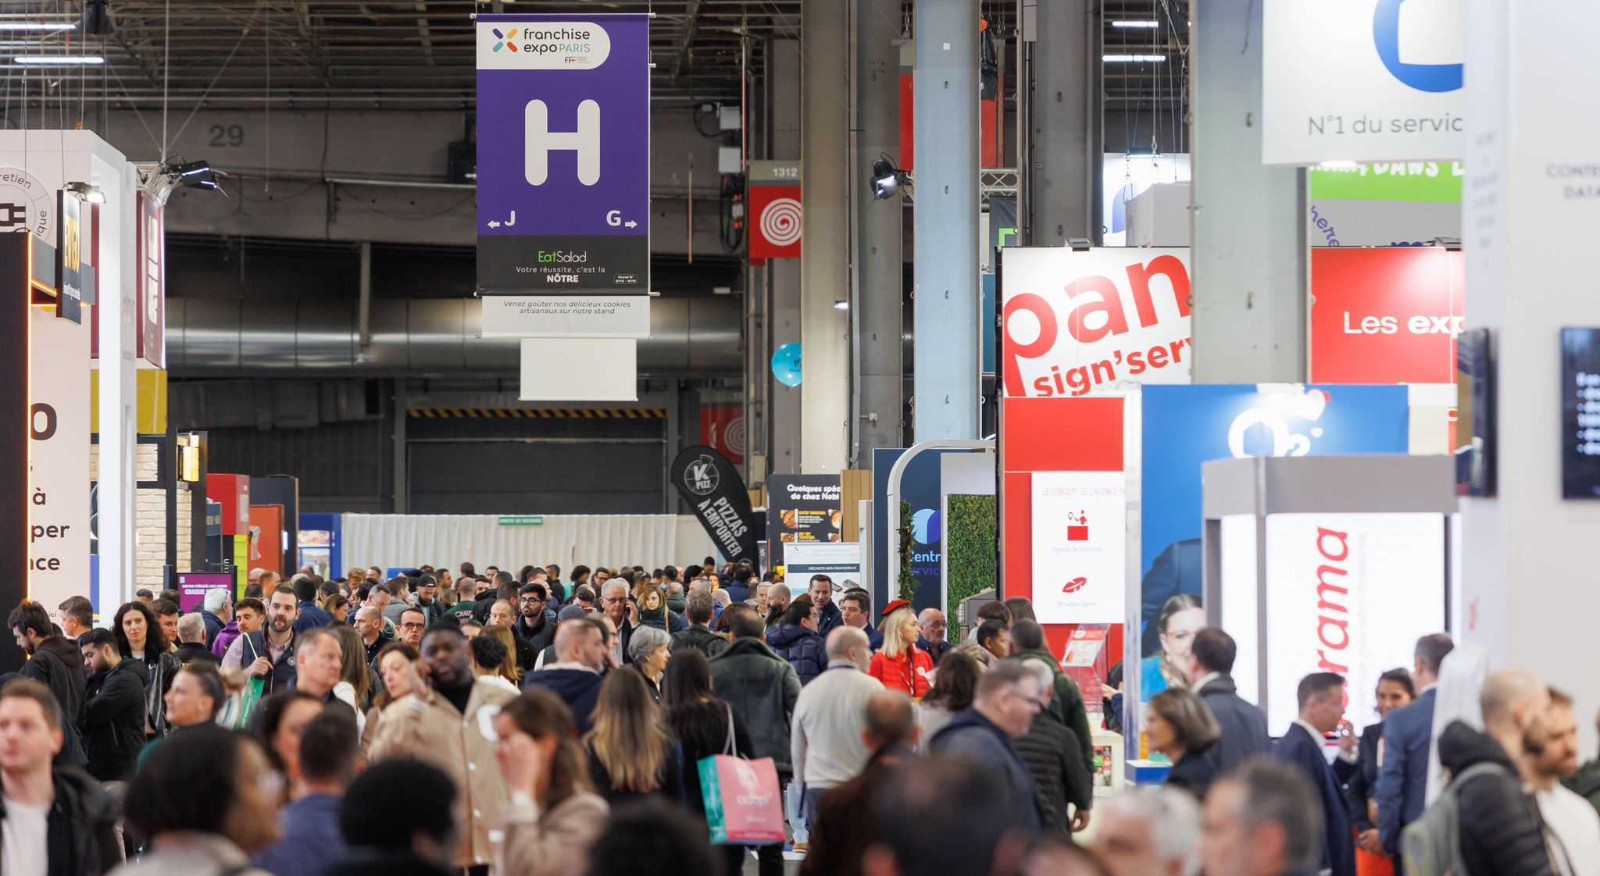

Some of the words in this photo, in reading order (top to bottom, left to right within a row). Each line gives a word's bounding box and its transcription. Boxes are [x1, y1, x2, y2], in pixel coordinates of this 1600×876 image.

[524, 28, 590, 40] franchise
[524, 43, 557, 56] expo
[559, 43, 591, 53] PARIS
[1308, 115, 1345, 135] N°1
[1352, 115, 1382, 134] du
[1390, 113, 1463, 132] servic
[209, 124, 244, 148] 29
[525, 99, 601, 186] H
[772, 167, 798, 177] 1312
[0, 174, 31, 190] etien
[504, 210, 516, 227] J
[606, 210, 621, 227] G
[538, 250, 587, 263] EatSalad
[516, 266, 537, 274] Votre
[576, 266, 596, 274] c'est
[547, 273, 579, 283] NÔTRE
[1003, 254, 1191, 397] pan
[1344, 311, 1398, 334] Les
[33, 487, 46, 505] à
[787, 484, 822, 493] Quelques
[713, 496, 748, 538] PIZZAS
[702, 506, 743, 558] EMPORTER
[911, 550, 941, 562] entr
[1317, 527, 1349, 707] rama
